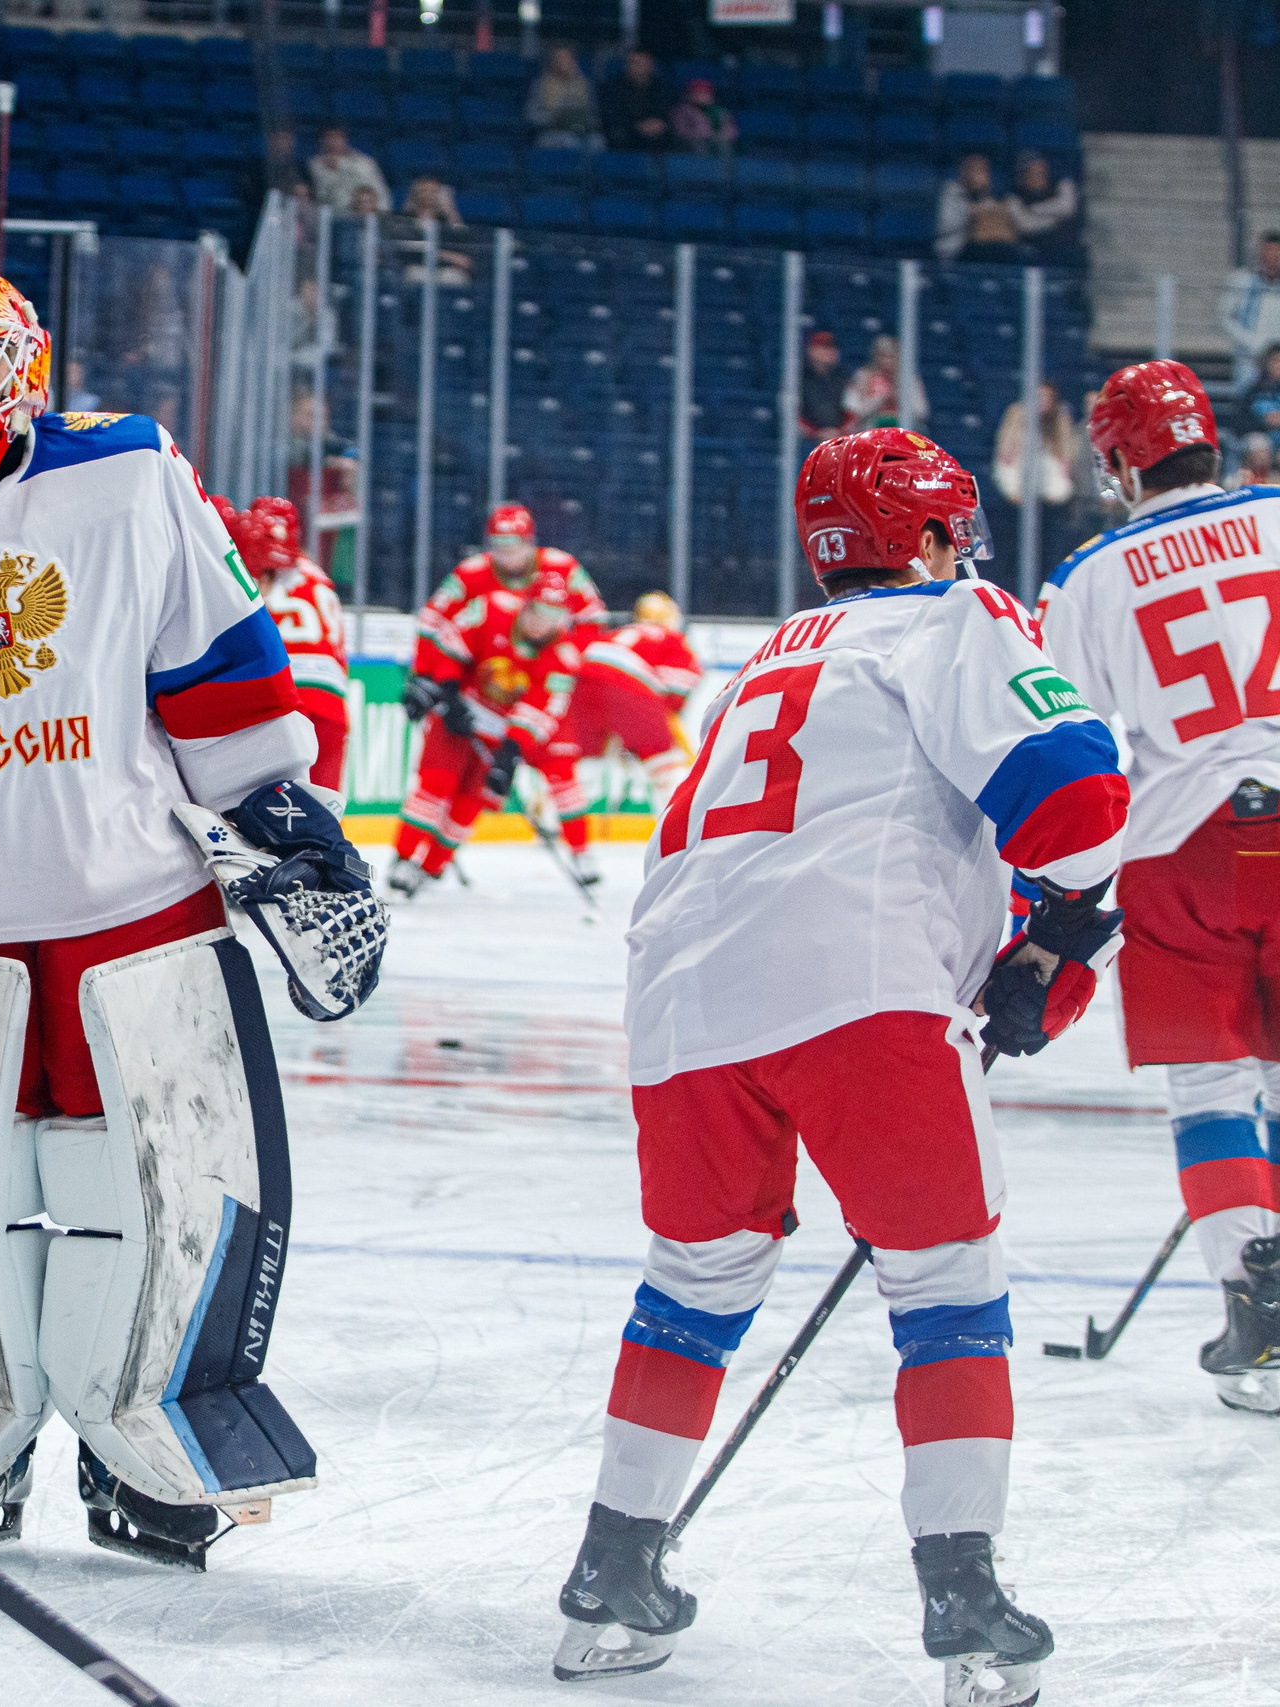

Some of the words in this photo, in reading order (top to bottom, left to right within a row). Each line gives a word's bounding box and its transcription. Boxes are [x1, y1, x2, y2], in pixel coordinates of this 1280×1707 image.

[817, 532, 848, 564] 43
[1133, 568, 1280, 745] 52
[1003, 1611, 1040, 1641] BAUER
